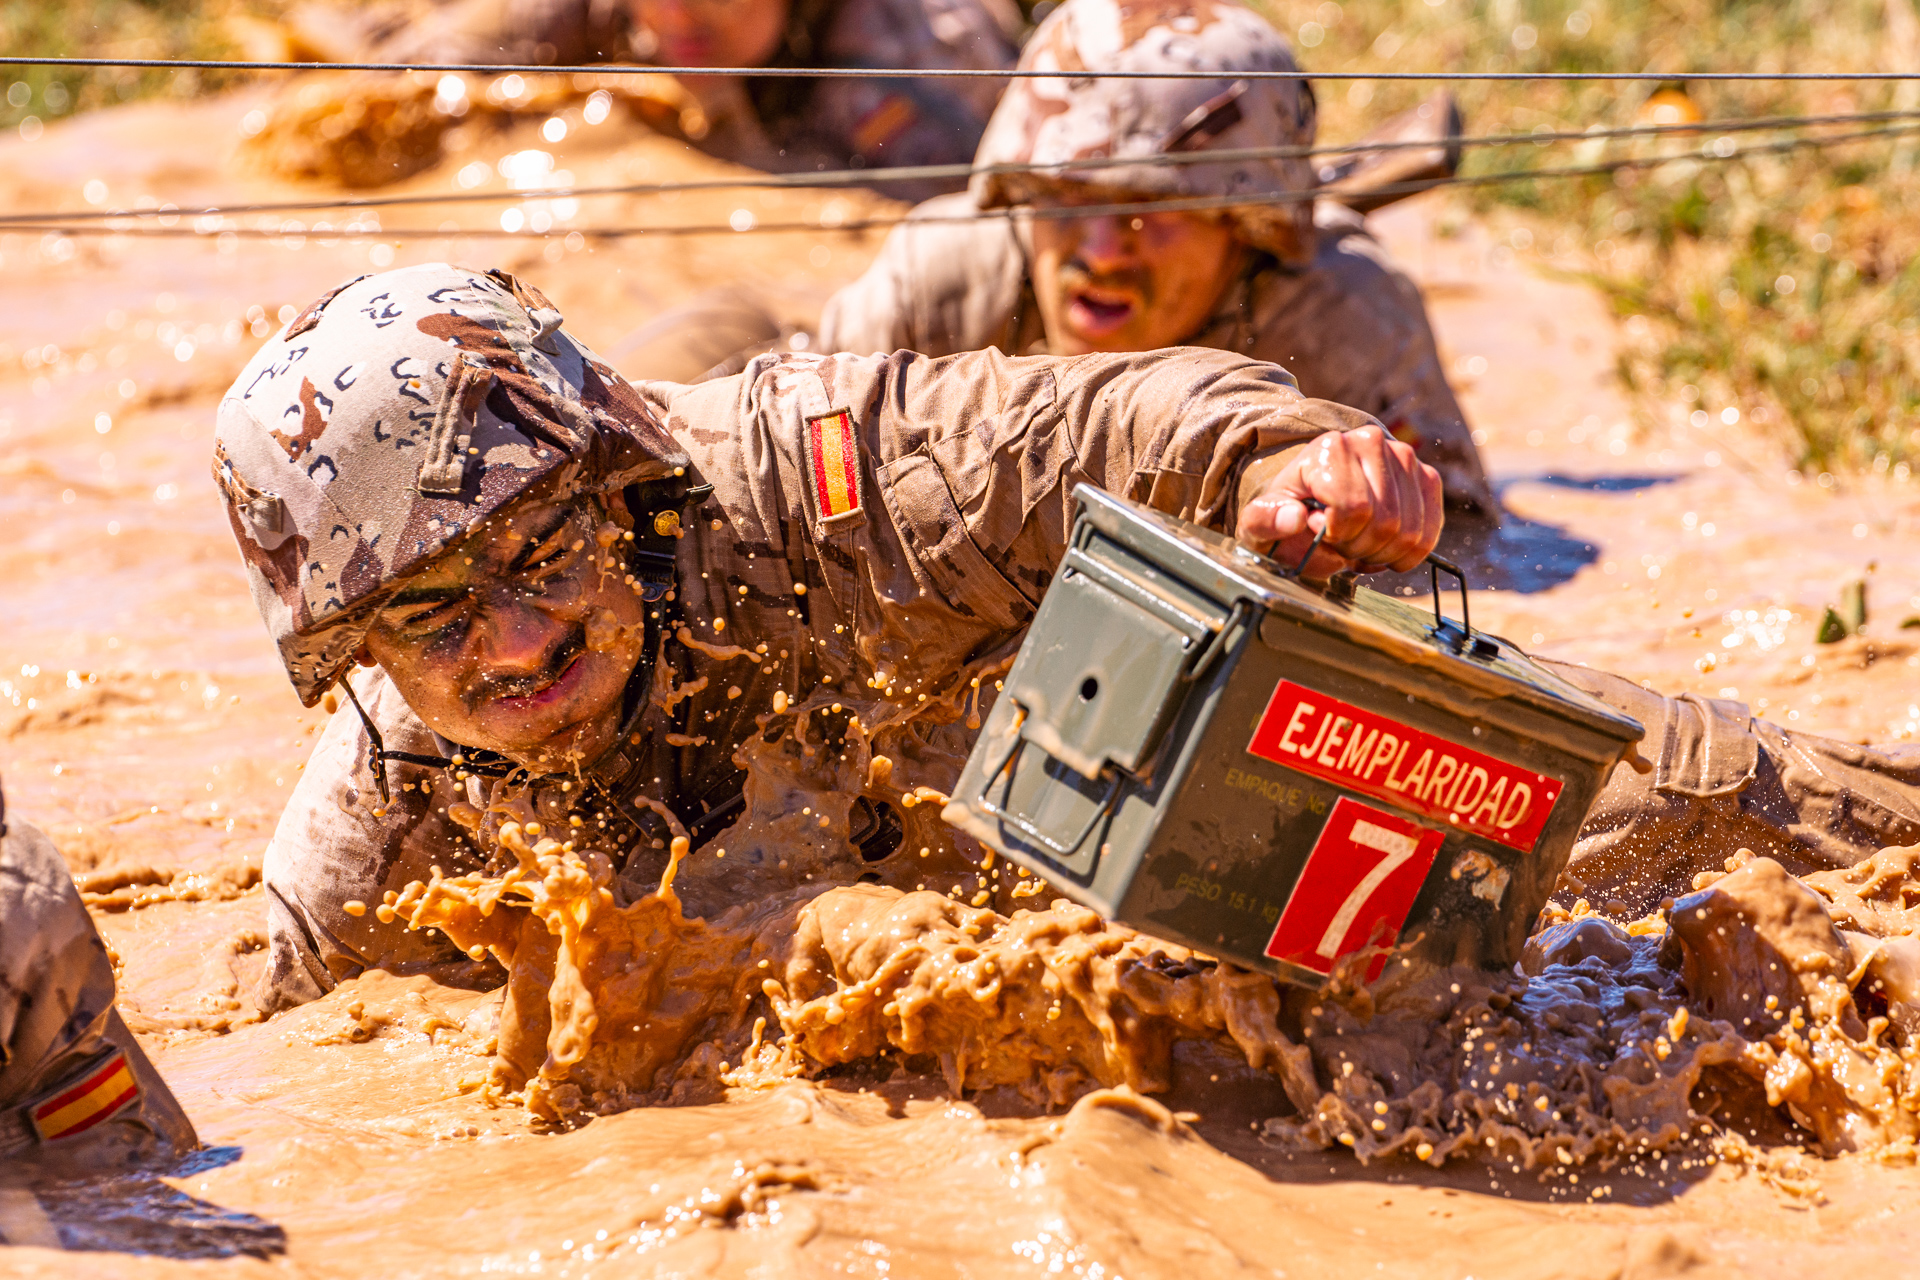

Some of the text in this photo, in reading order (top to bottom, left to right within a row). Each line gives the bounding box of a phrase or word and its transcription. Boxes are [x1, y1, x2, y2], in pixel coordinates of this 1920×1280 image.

[1224, 767, 1302, 807] EMPAQUE
[1278, 701, 1532, 829] EJEMPLARIDAD
[1174, 872, 1222, 902] PESO
[1261, 901, 1280, 924] kg
[1315, 818, 1421, 960] 7
